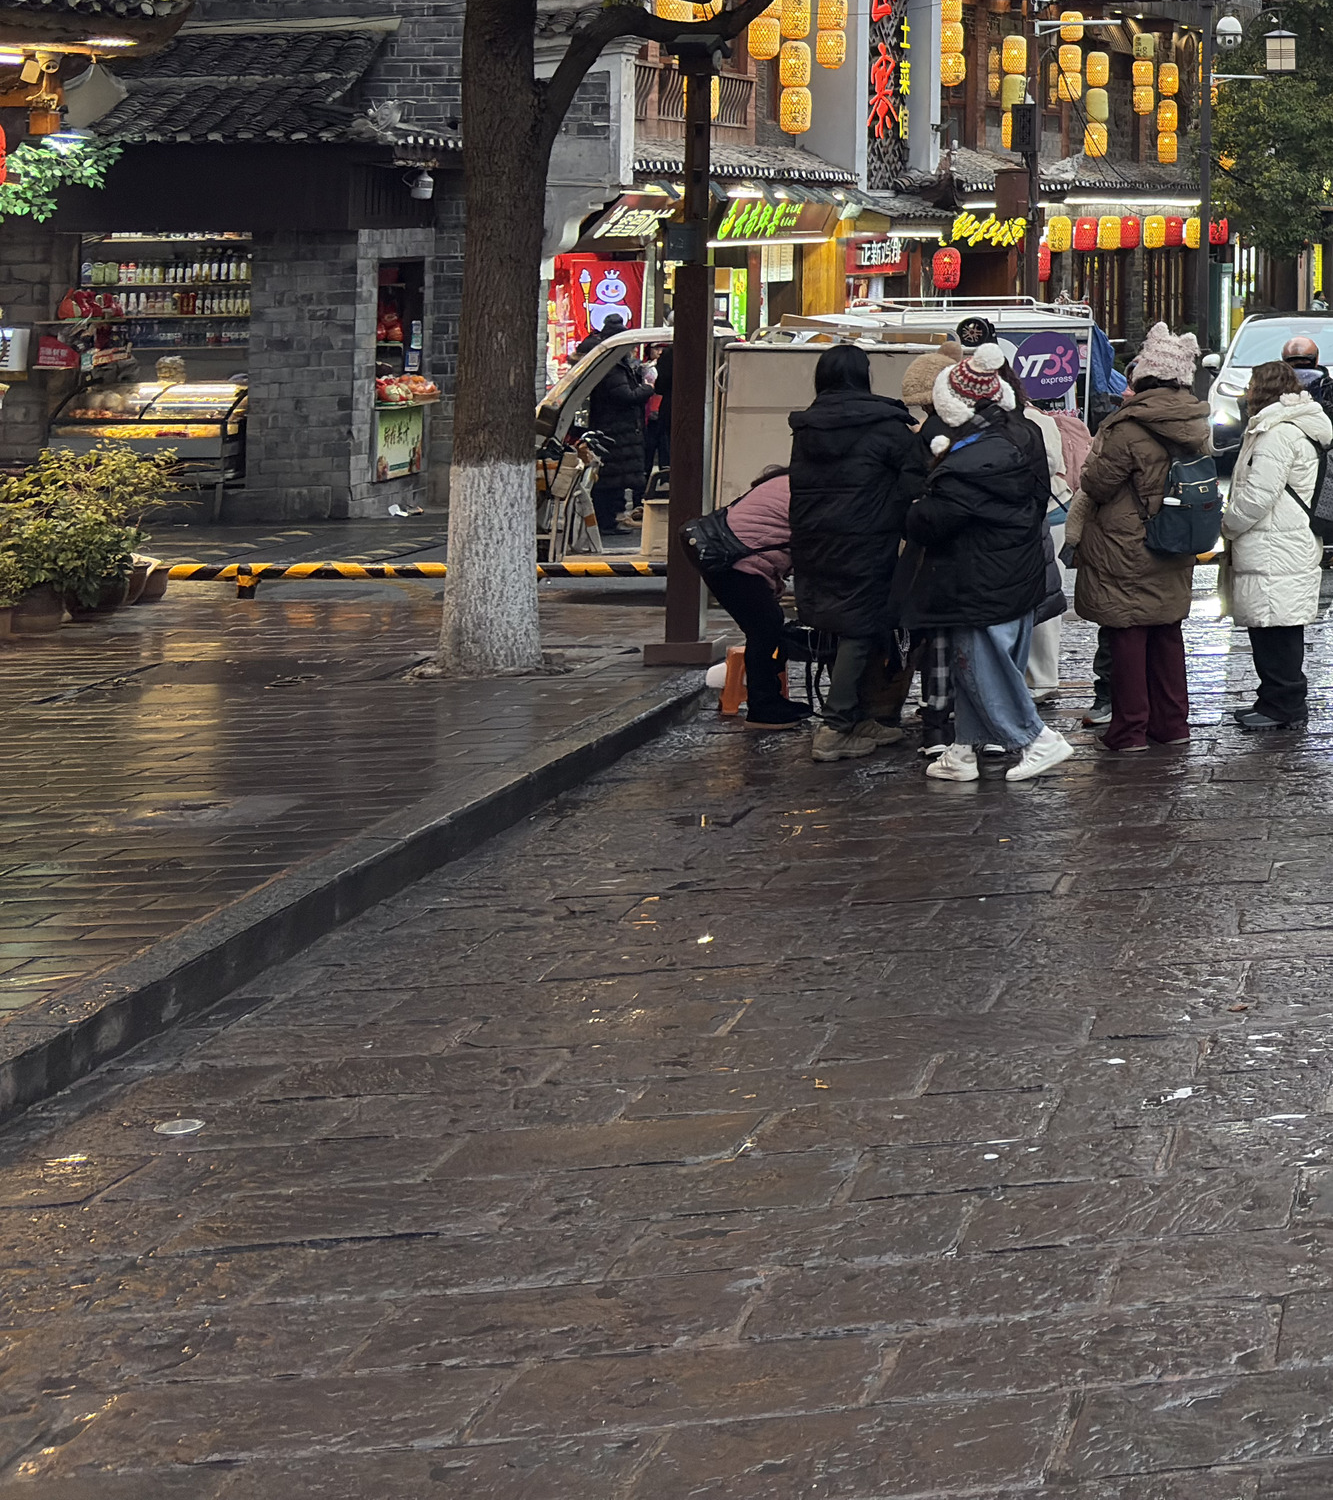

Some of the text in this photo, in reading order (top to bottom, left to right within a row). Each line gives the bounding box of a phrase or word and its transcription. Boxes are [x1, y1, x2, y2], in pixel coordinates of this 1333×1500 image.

[861, 238, 902, 266] 正新鸡排
[1040, 376, 1073, 385] express
